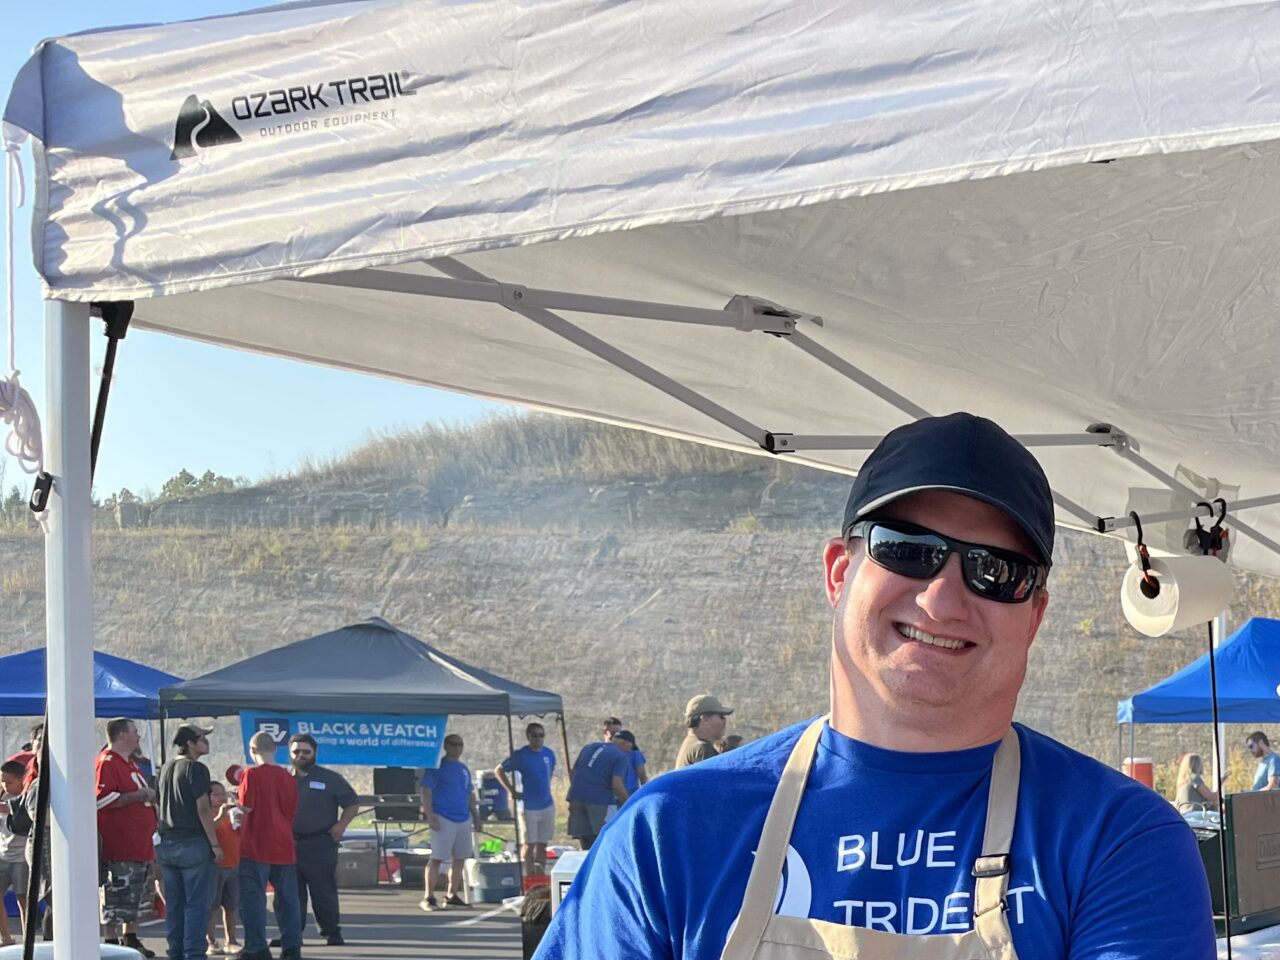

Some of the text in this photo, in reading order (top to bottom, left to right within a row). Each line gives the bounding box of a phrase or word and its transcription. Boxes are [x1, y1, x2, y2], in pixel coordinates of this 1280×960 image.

[259, 109, 396, 137] OUTDOOR EQUIPMENT
[298, 722, 438, 738] BLACK & VEATCH
[346, 737, 379, 747] world
[837, 829, 956, 872] BLUE
